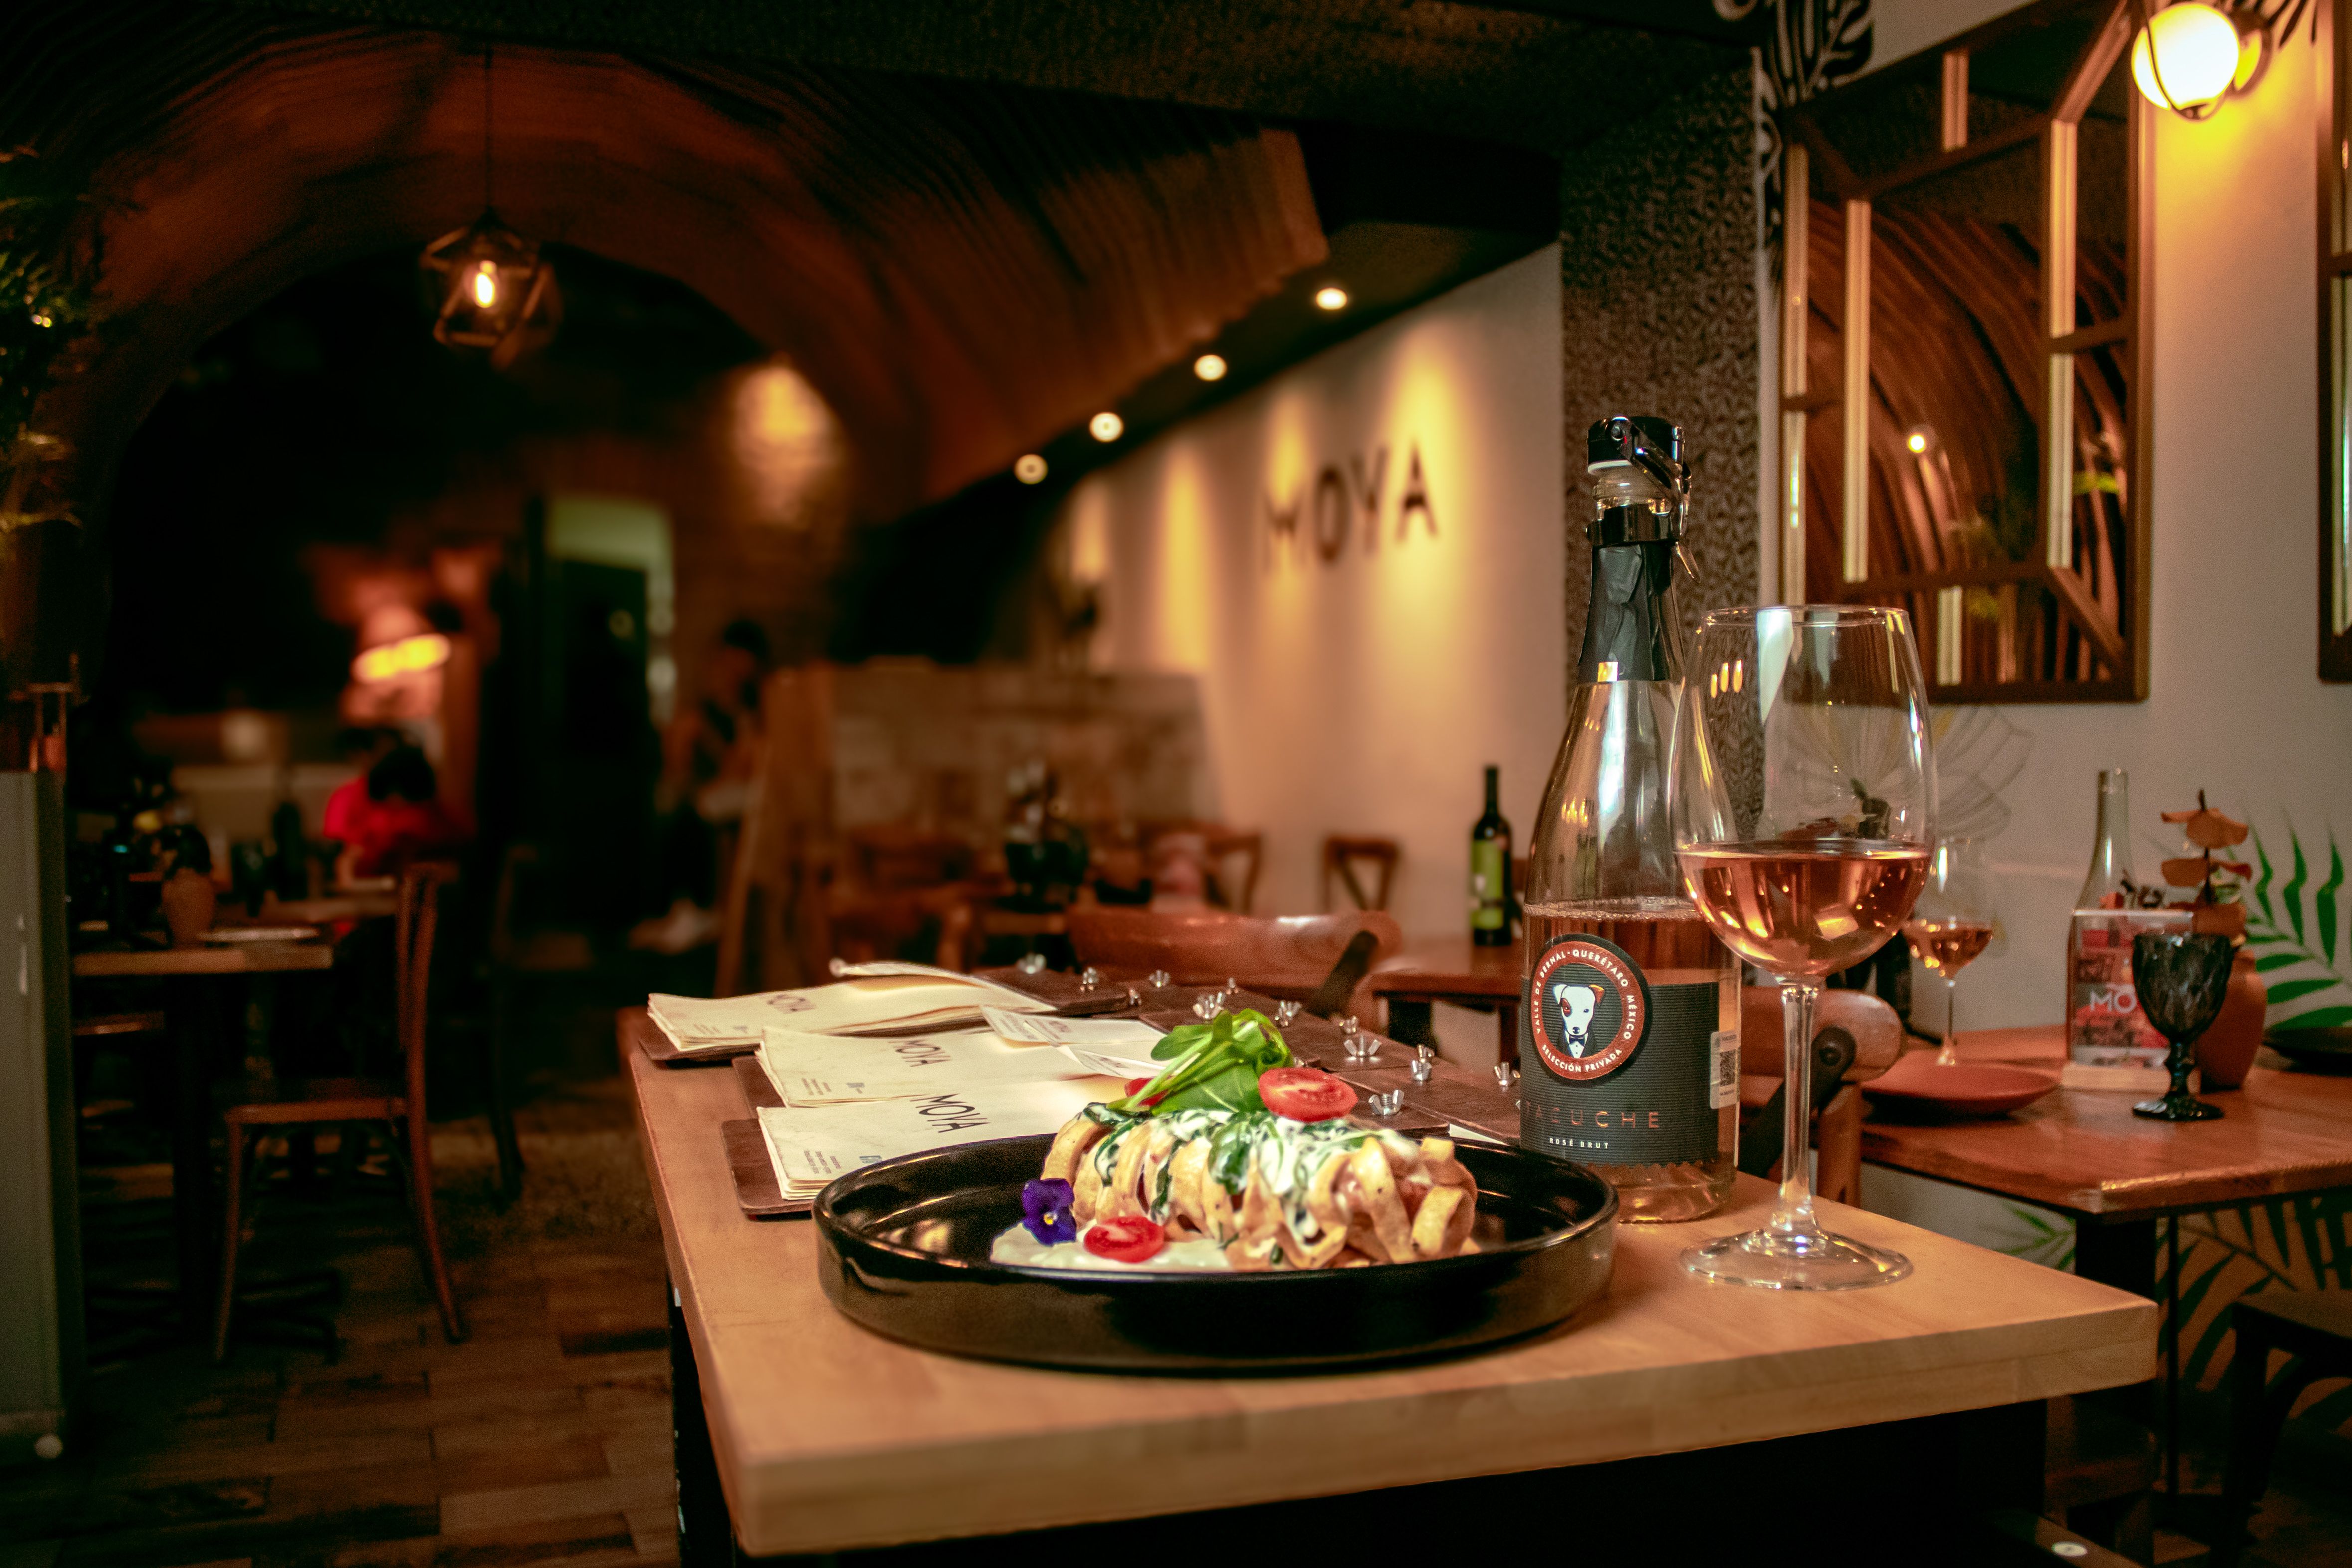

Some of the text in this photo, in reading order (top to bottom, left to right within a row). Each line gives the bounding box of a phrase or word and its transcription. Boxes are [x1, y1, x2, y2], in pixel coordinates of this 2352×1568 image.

[1535, 981, 1542, 995] DE
[1539, 951, 1566, 978] BERNAL
[1572, 949, 1629, 987] QUERÉTARO
[1623, 995, 1638, 1039] MÉXICO
[889, 1039, 951, 1067] MOYA
[1542, 1044, 1622, 1072] SELECCIÓN PRIVADA
[910, 1093, 991, 1133] MOYA
[1549, 1137, 1573, 1146] ROSÉ
